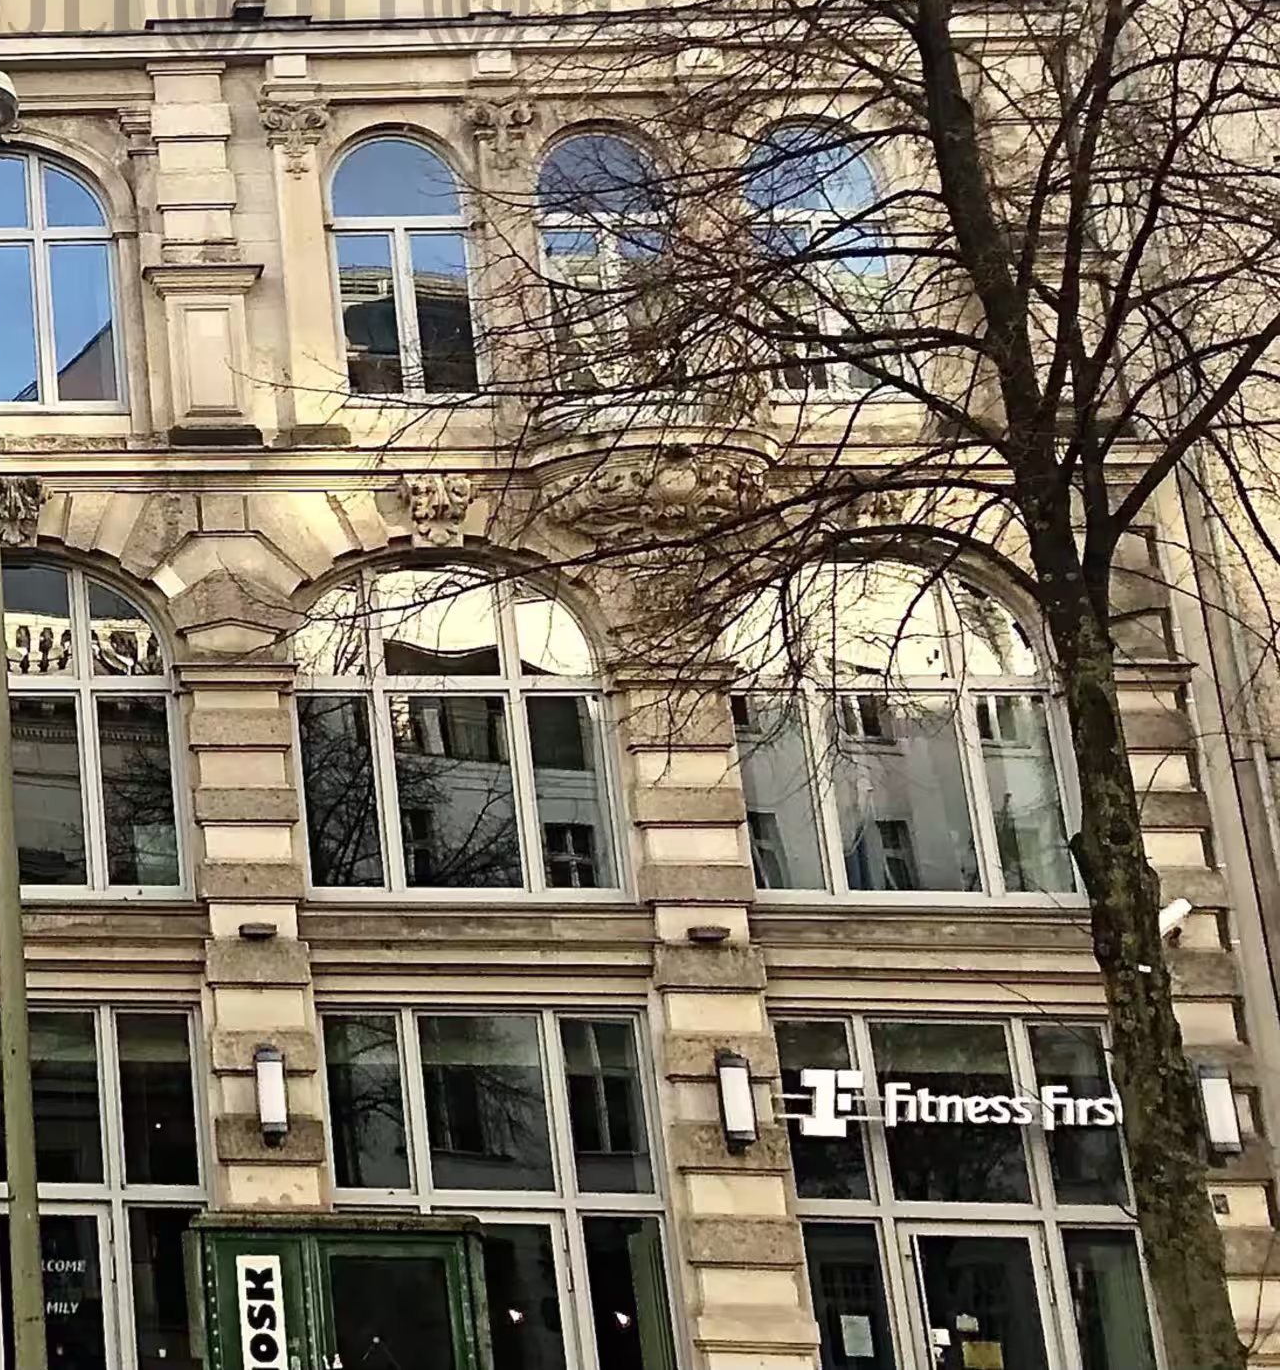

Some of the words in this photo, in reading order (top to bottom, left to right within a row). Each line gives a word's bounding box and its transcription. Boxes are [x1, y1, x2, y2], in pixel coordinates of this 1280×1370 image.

[885, 1082, 1033, 1127] Fitness
[40, 1259, 87, 1273] LCOME
[46, 1301, 80, 1315] MILY
[243, 1266, 281, 1370] OSK
